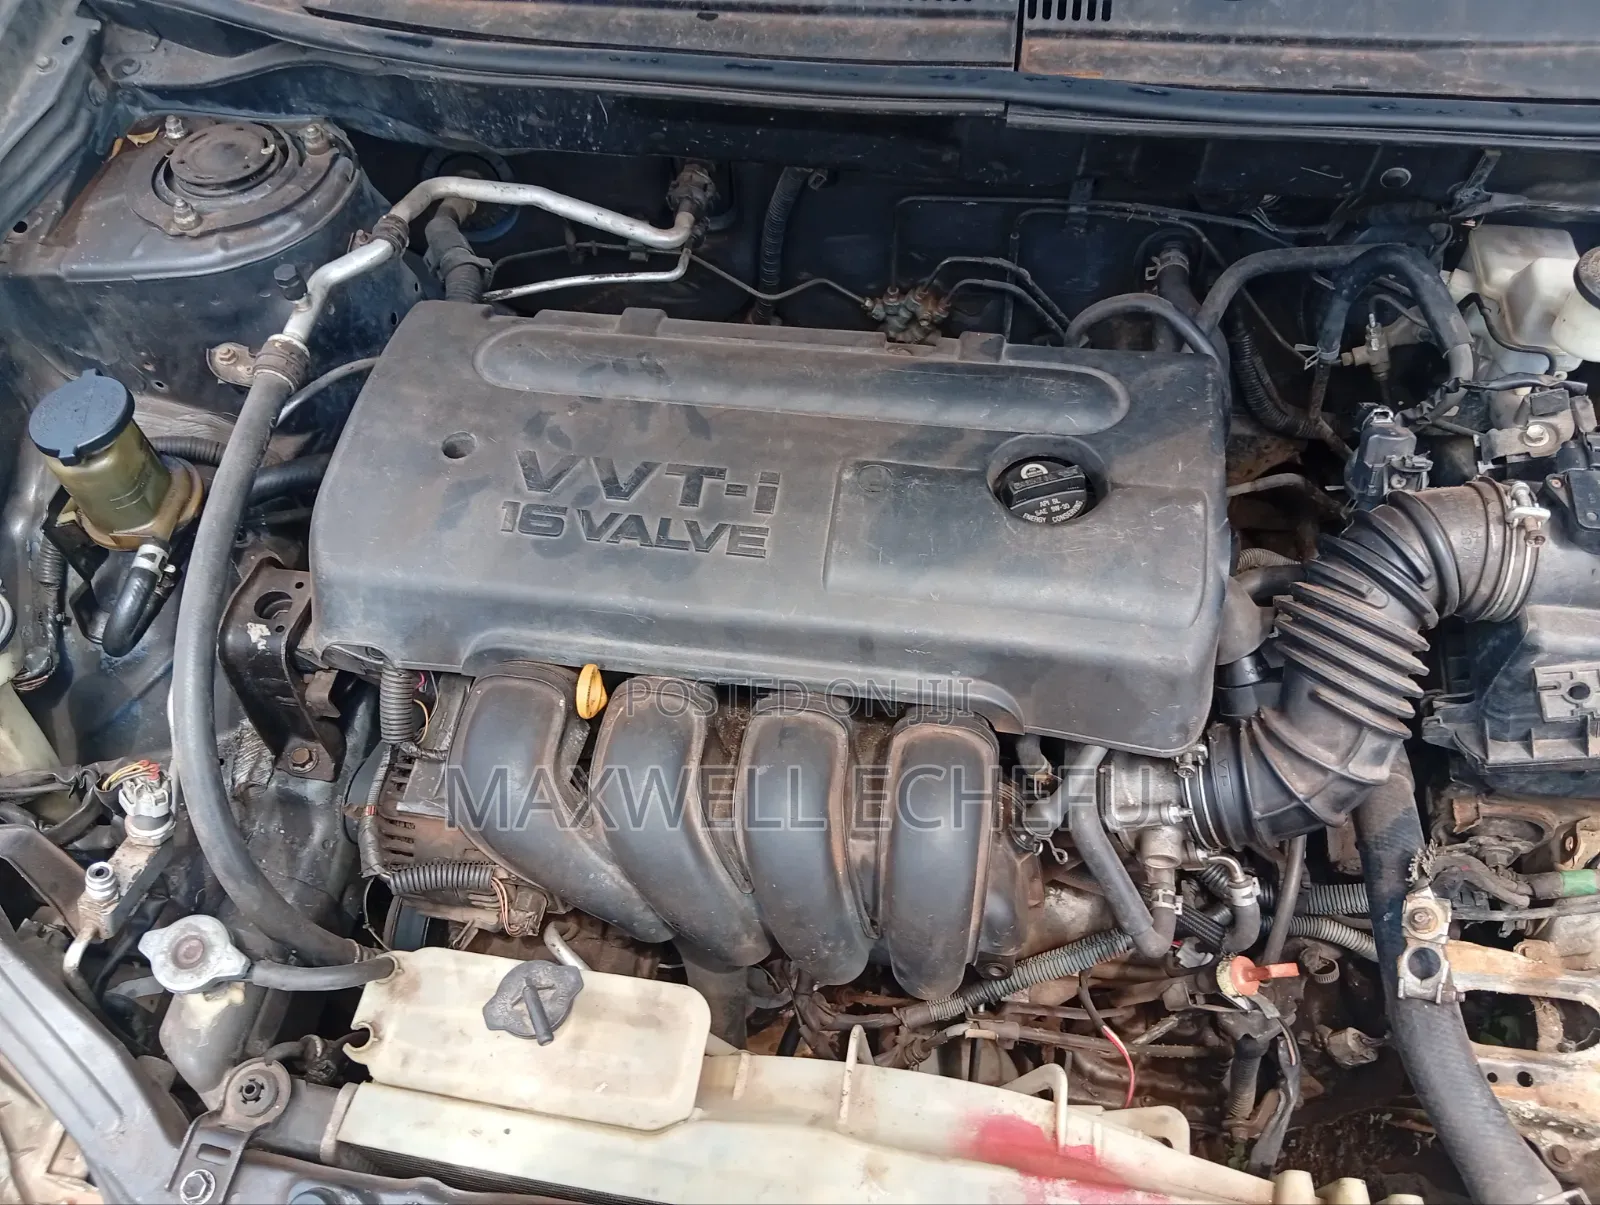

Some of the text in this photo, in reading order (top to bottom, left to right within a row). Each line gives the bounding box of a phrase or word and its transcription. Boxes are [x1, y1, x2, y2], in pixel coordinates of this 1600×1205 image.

[514, 450, 782, 514] VVT-i
[500, 502, 771, 558] 16 VALVE
[1022, 500, 1083, 523] ENERGY CONSERVING
[1034, 508, 1048, 516] SAE
